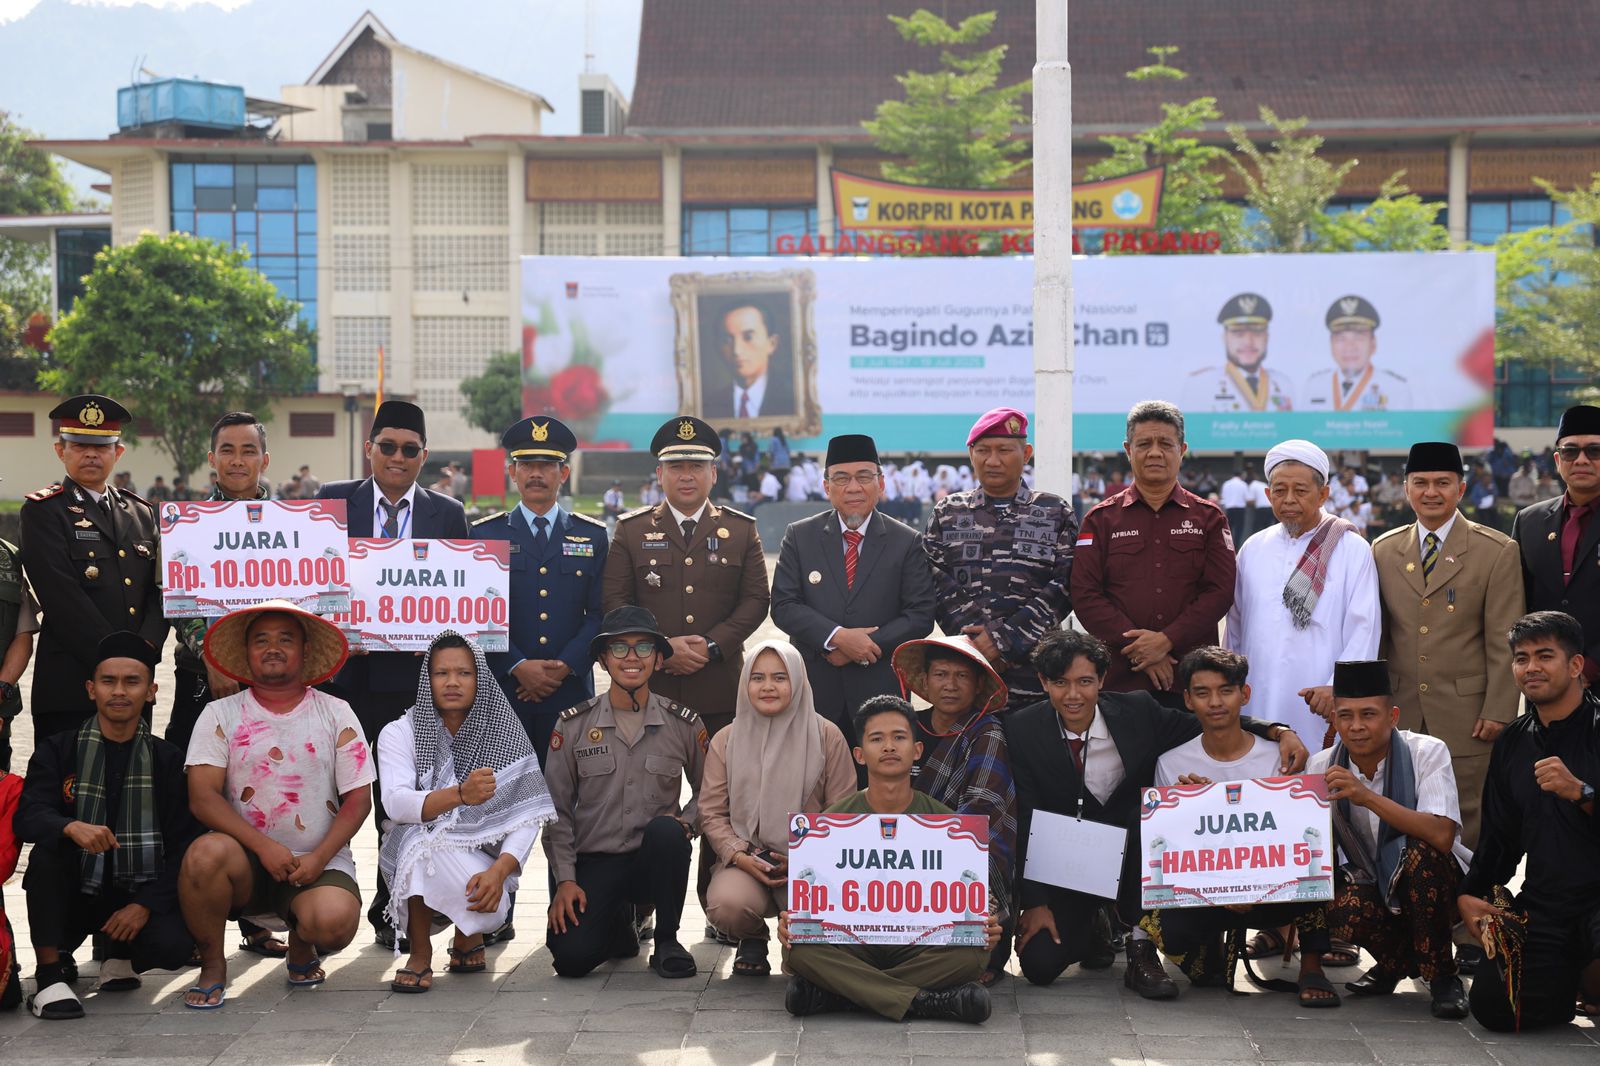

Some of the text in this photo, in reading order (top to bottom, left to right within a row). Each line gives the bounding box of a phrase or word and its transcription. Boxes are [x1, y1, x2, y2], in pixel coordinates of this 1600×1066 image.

[878, 202, 1103, 220] KORPRI KOTA PNG
[776, 233, 979, 254] GALANGGANG
[1104, 231, 1221, 252] PADANG
[850, 303, 940, 316] Memperingati
[944, 304, 1008, 316] Gugurnya
[1080, 303, 1137, 315] Nasional
[851, 322, 978, 351] Bagindo
[987, 322, 1034, 346] Azi
[213, 531, 299, 550] JUARA I
[1020, 529, 1054, 540] TNI AL
[1111, 530, 1139, 539] AFRIADI
[168, 557, 345, 591] Rp. 10.000.000
[376, 569, 465, 587] JUARA II
[226, 598, 252, 606] NAPAK
[378, 595, 506, 624] 8.000.000
[388, 633, 413, 641] NAPAK
[576, 745, 608, 758] ZULKIFLI
[1194, 811, 1277, 836] JUARA
[836, 848, 943, 870] JUARA III
[1162, 843, 1311, 874] HARAPAN 5
[793, 879, 986, 914] Rp. 6.000.000
[1202, 885, 1229, 894] NAPAK
[1230, 884, 1252, 892] TILAS
[853, 924, 881, 932] NAPAK
[882, 924, 905, 932] TILAS
[963, 936, 986, 944] CHAN
